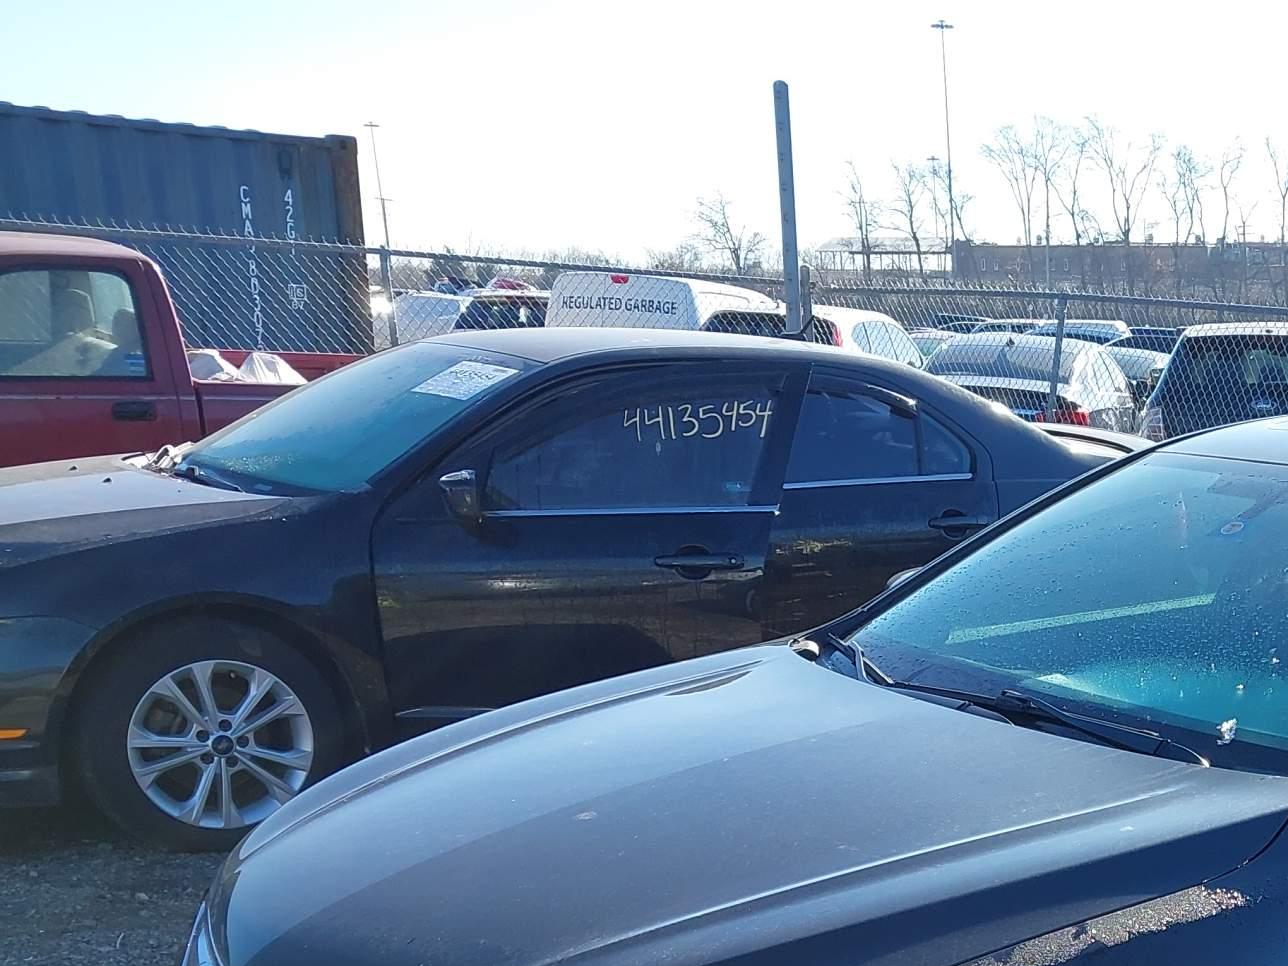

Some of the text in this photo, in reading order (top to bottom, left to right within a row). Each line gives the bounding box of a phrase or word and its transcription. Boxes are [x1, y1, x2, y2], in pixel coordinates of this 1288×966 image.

[561, 295, 678, 315] REGULATED GARBAGE
[623, 399, 773, 442] 44135454
